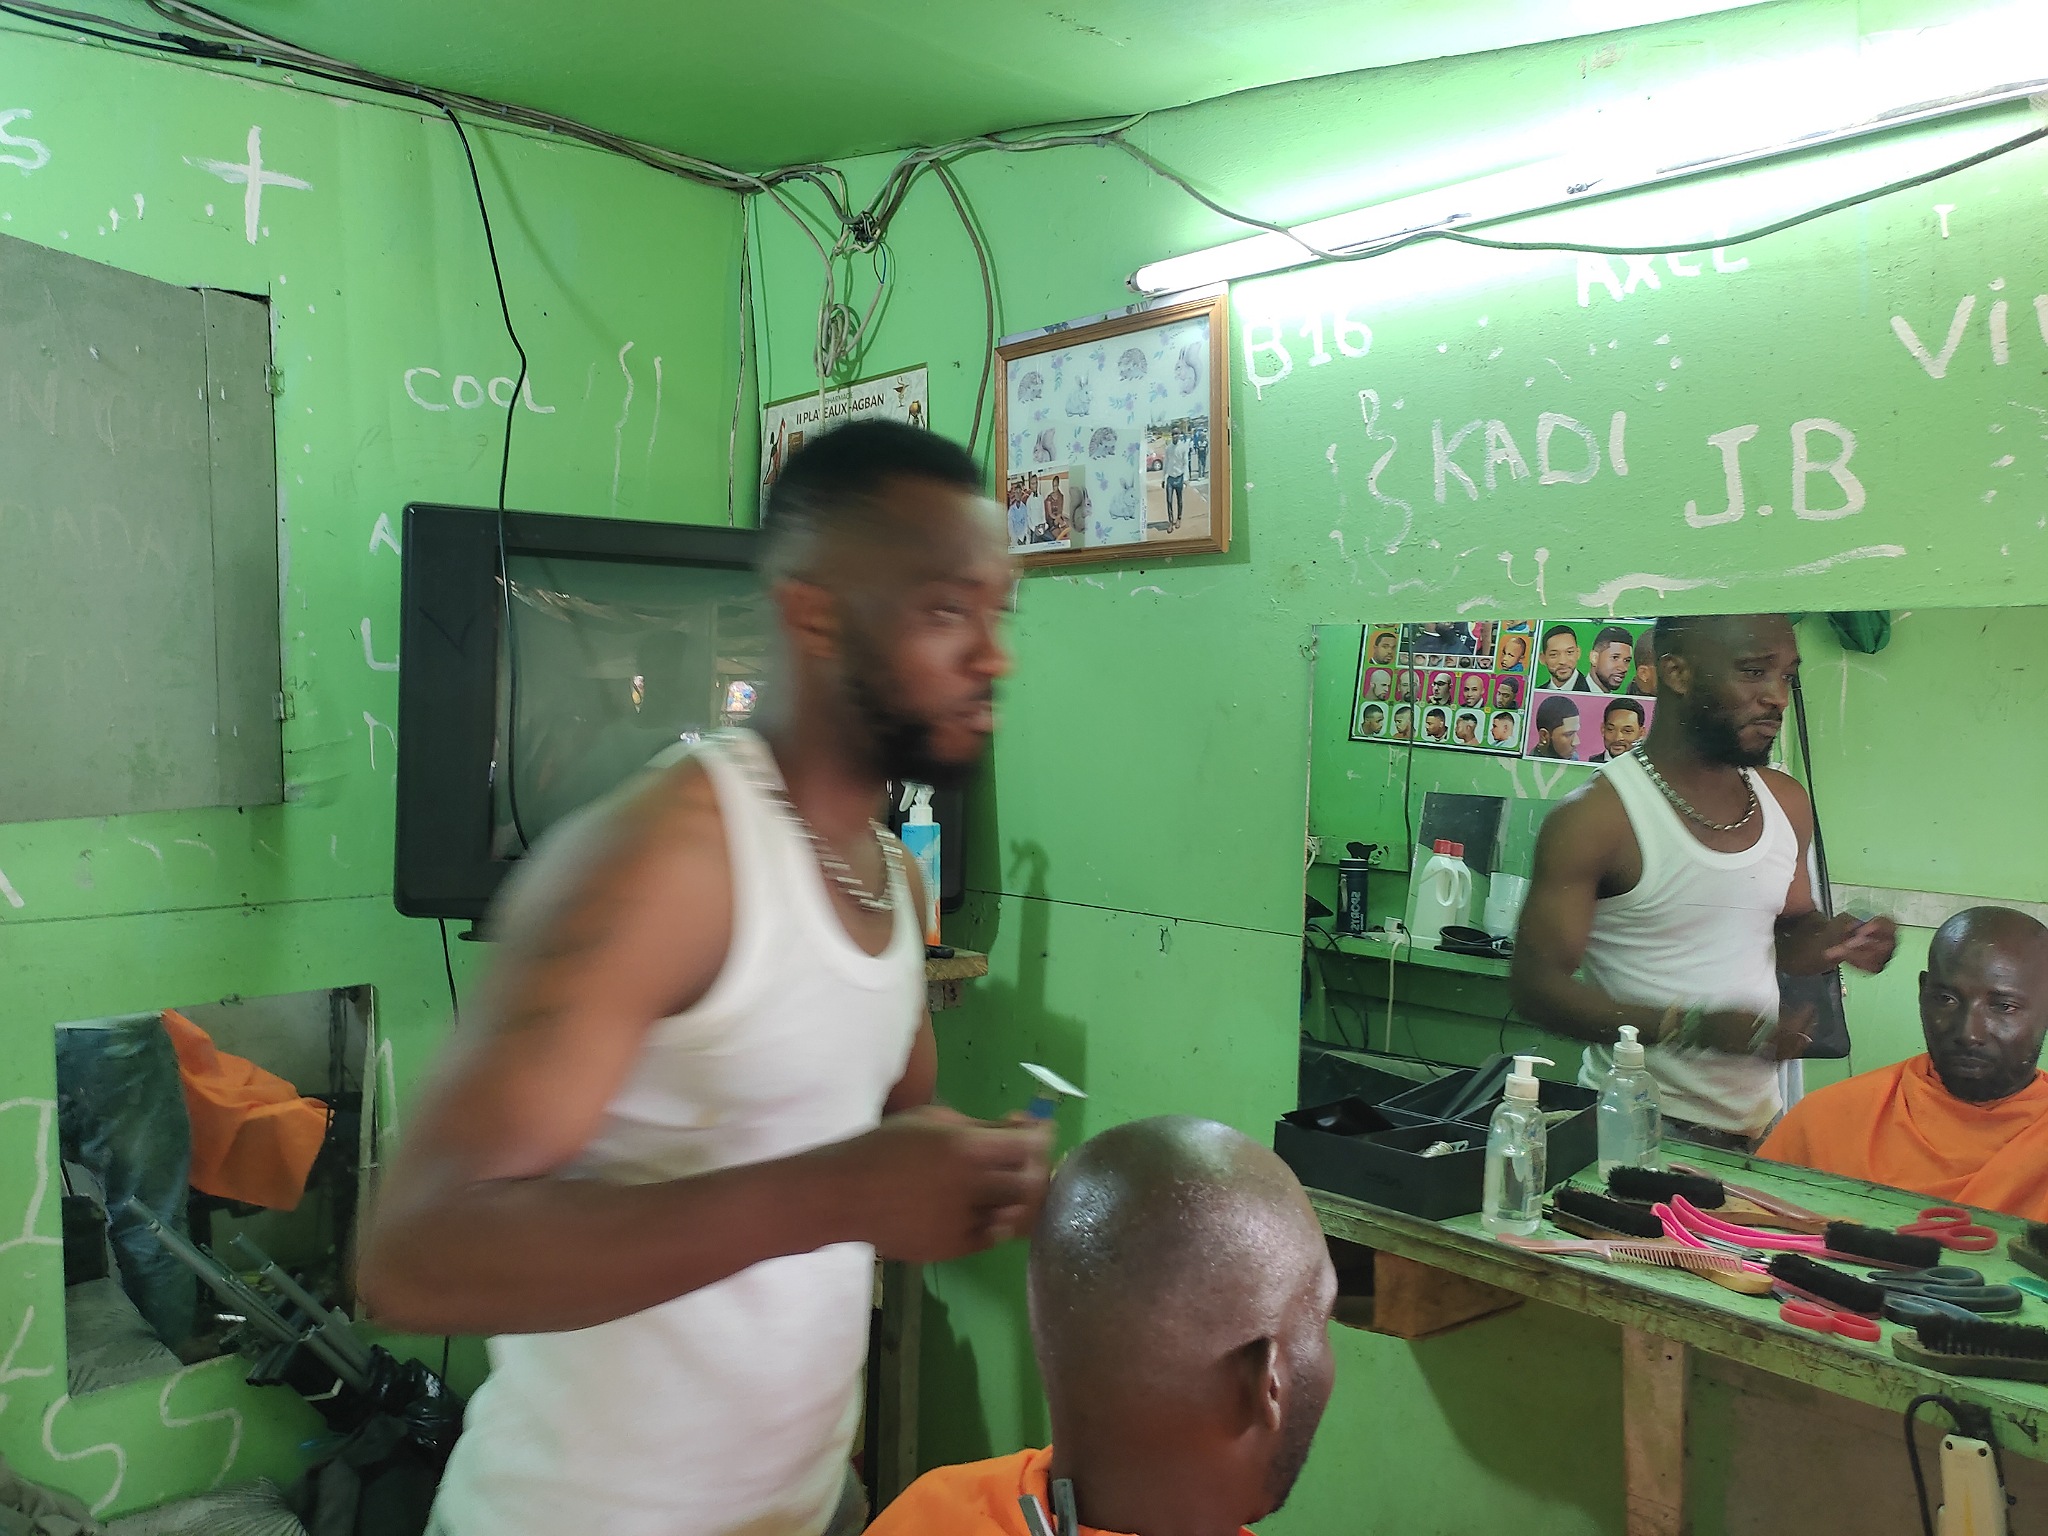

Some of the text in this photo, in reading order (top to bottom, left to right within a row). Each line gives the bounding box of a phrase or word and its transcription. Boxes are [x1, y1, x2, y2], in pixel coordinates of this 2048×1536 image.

[1242, 312, 1374, 401] B16
[1432, 410, 1628, 504] KADI
[1684, 417, 1867, 530] J.B
